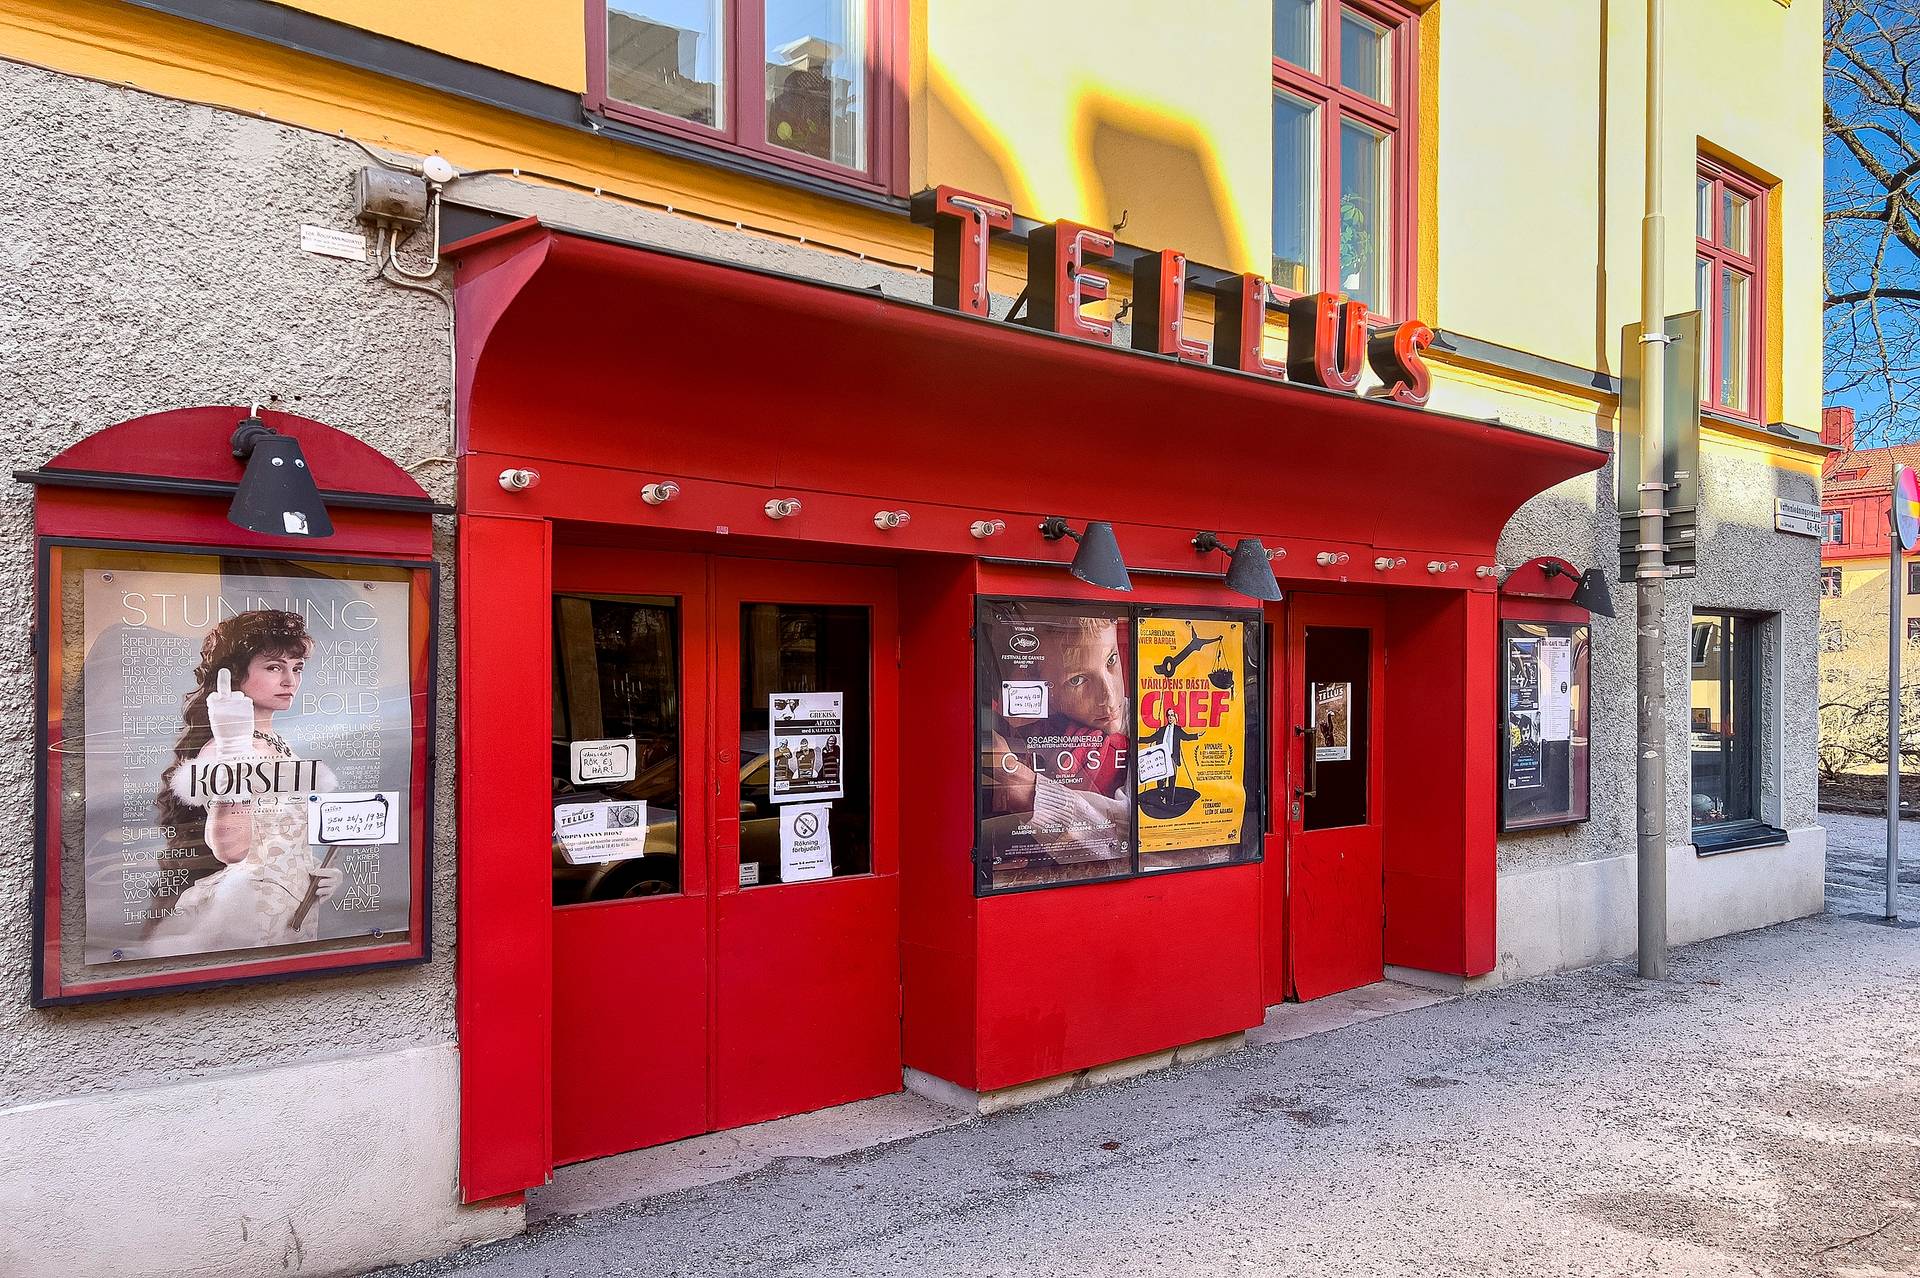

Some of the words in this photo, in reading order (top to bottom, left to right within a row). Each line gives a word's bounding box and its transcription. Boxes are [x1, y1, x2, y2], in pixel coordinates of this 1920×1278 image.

[922, 185, 1434, 404] TELLUS
[122, 638, 190, 647] KREUTZER'S
[320, 640, 378, 656] VICKY
[122, 647, 191, 657] RENDITION
[122, 657, 141, 666] OF
[145, 657, 174, 666] ONE
[178, 656, 197, 666] OF
[322, 655, 379, 671] KRIEPS
[122, 666, 183, 676] HISTORY'S
[123, 676, 172, 685] TRAGIC
[316, 670, 379, 686] SHINES
[1140, 677, 1183, 689] VÄRLDENS
[1185, 677, 1210, 689] BÄSTA
[122, 685, 158, 695] TALES
[162, 685, 173, 694] IS
[1319, 687, 1344, 701] TELLUS
[122, 695, 177, 705] INSPIRED
[302, 692, 380, 715] BOLD
[1140, 690, 1230, 728] CHEF
[123, 720, 183, 735] FIERCE
[295, 725, 303, 733] A
[306, 722, 380, 732] COMPELLING
[298, 732, 349, 742] PORTRAIT
[354, 732, 369, 741] OF
[373, 732, 380, 740] A
[1026, 735, 1104, 744] OSCARSNOMINERAD
[124, 745, 134, 755] A
[139, 744, 168, 755] STAR
[310, 740, 381, 750] DISAFFECTED
[334, 748, 380, 758] WOMAN
[124, 755, 158, 766] TURN
[1001, 749, 1127, 773] CLOSE
[190, 760, 322, 797] KORSETT
[123, 799, 157, 807] WOMAN
[561, 812, 595, 825] TELLUS
[122, 826, 177, 840] SUPERB
[123, 848, 199, 862] WONDERFUL
[792, 845, 821, 853] förbjuden
[343, 860, 380, 874] WITH
[123, 869, 174, 881] DEDICATED
[177, 868, 189, 876] TO
[352, 872, 379, 885] WIT
[123, 876, 189, 890] COMPLEX
[123, 886, 179, 900] WOMEN
[345, 884, 380, 898] AND
[331, 896, 380, 911] VERVE
[124, 907, 184, 920] THRILLING
